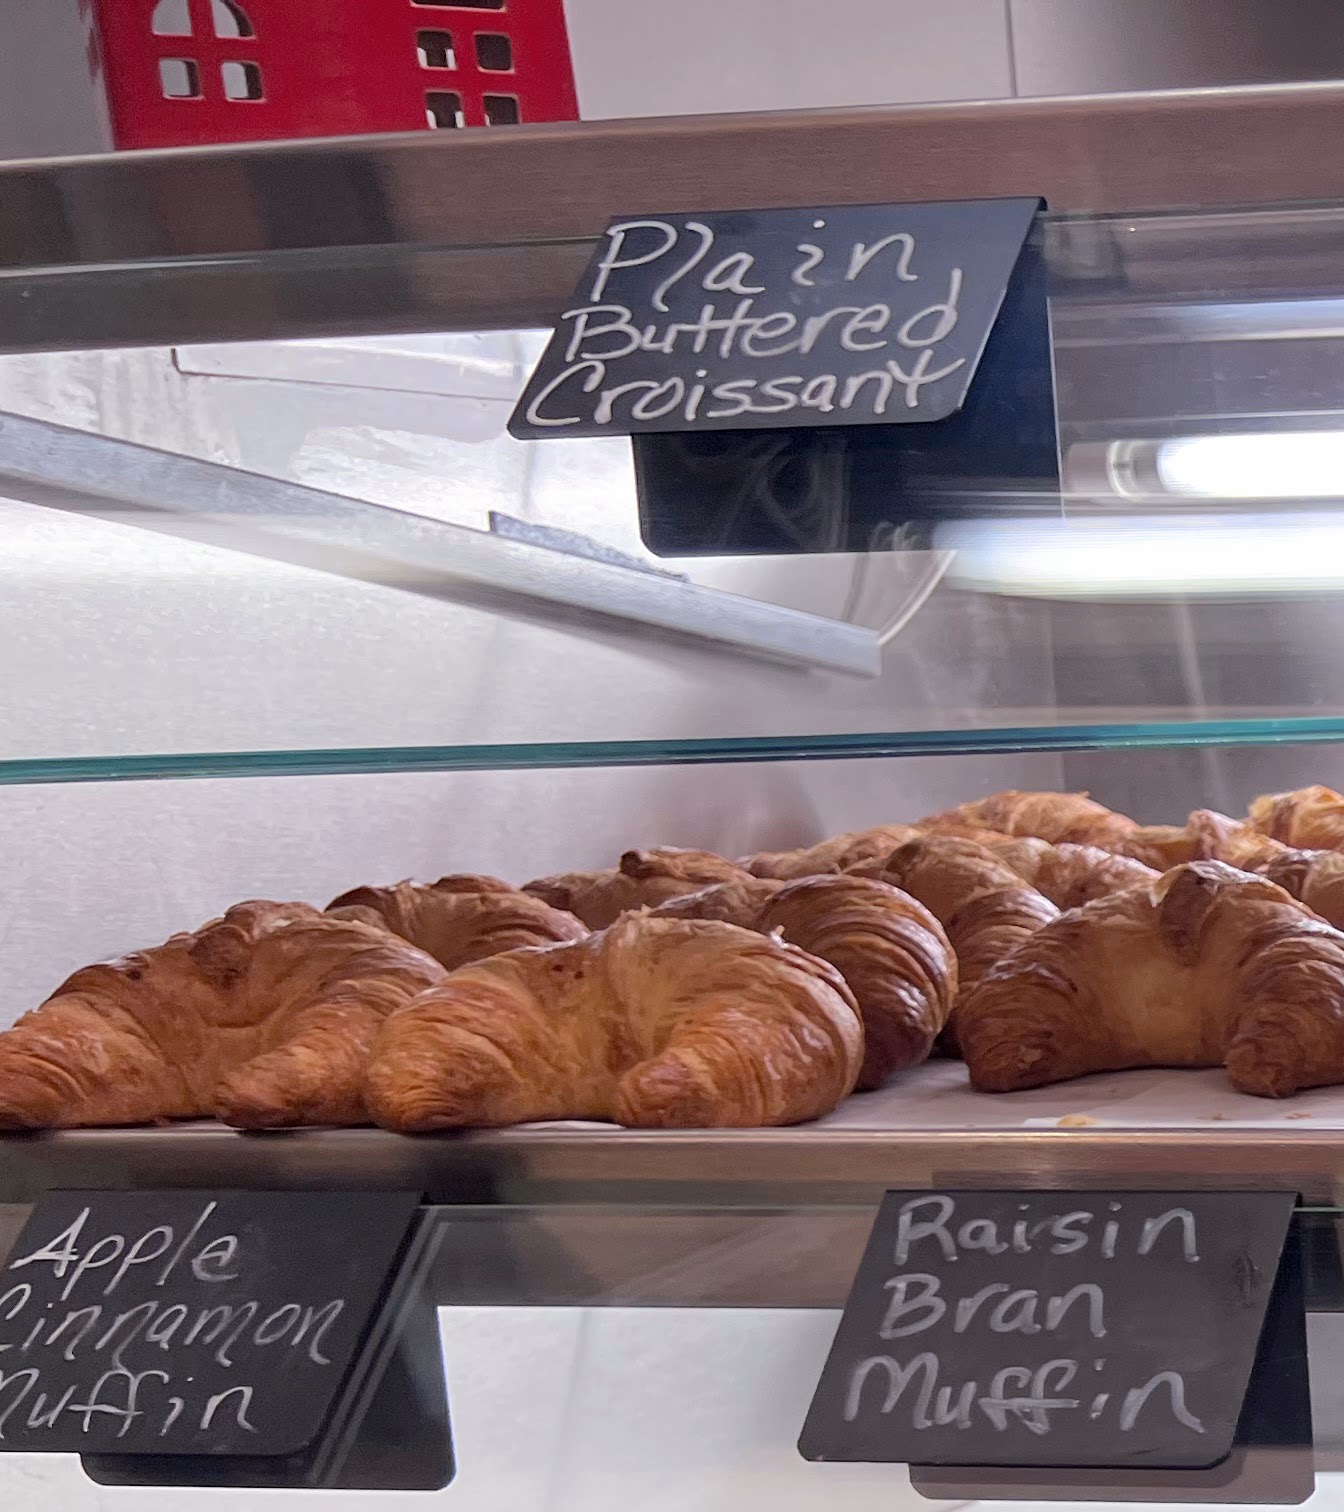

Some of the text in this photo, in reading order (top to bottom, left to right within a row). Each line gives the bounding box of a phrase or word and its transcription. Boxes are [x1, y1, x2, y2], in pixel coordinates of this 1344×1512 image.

[590, 219, 918, 312] Plain
[561, 267, 964, 363] Buttered
[525, 348, 966, 427] Croissant
[8, 1200, 239, 1301] Apple
[893, 1194, 1201, 1266] Raisin
[879, 1272, 1108, 1340] Bran
[843, 1350, 1206, 1436] Muffin
